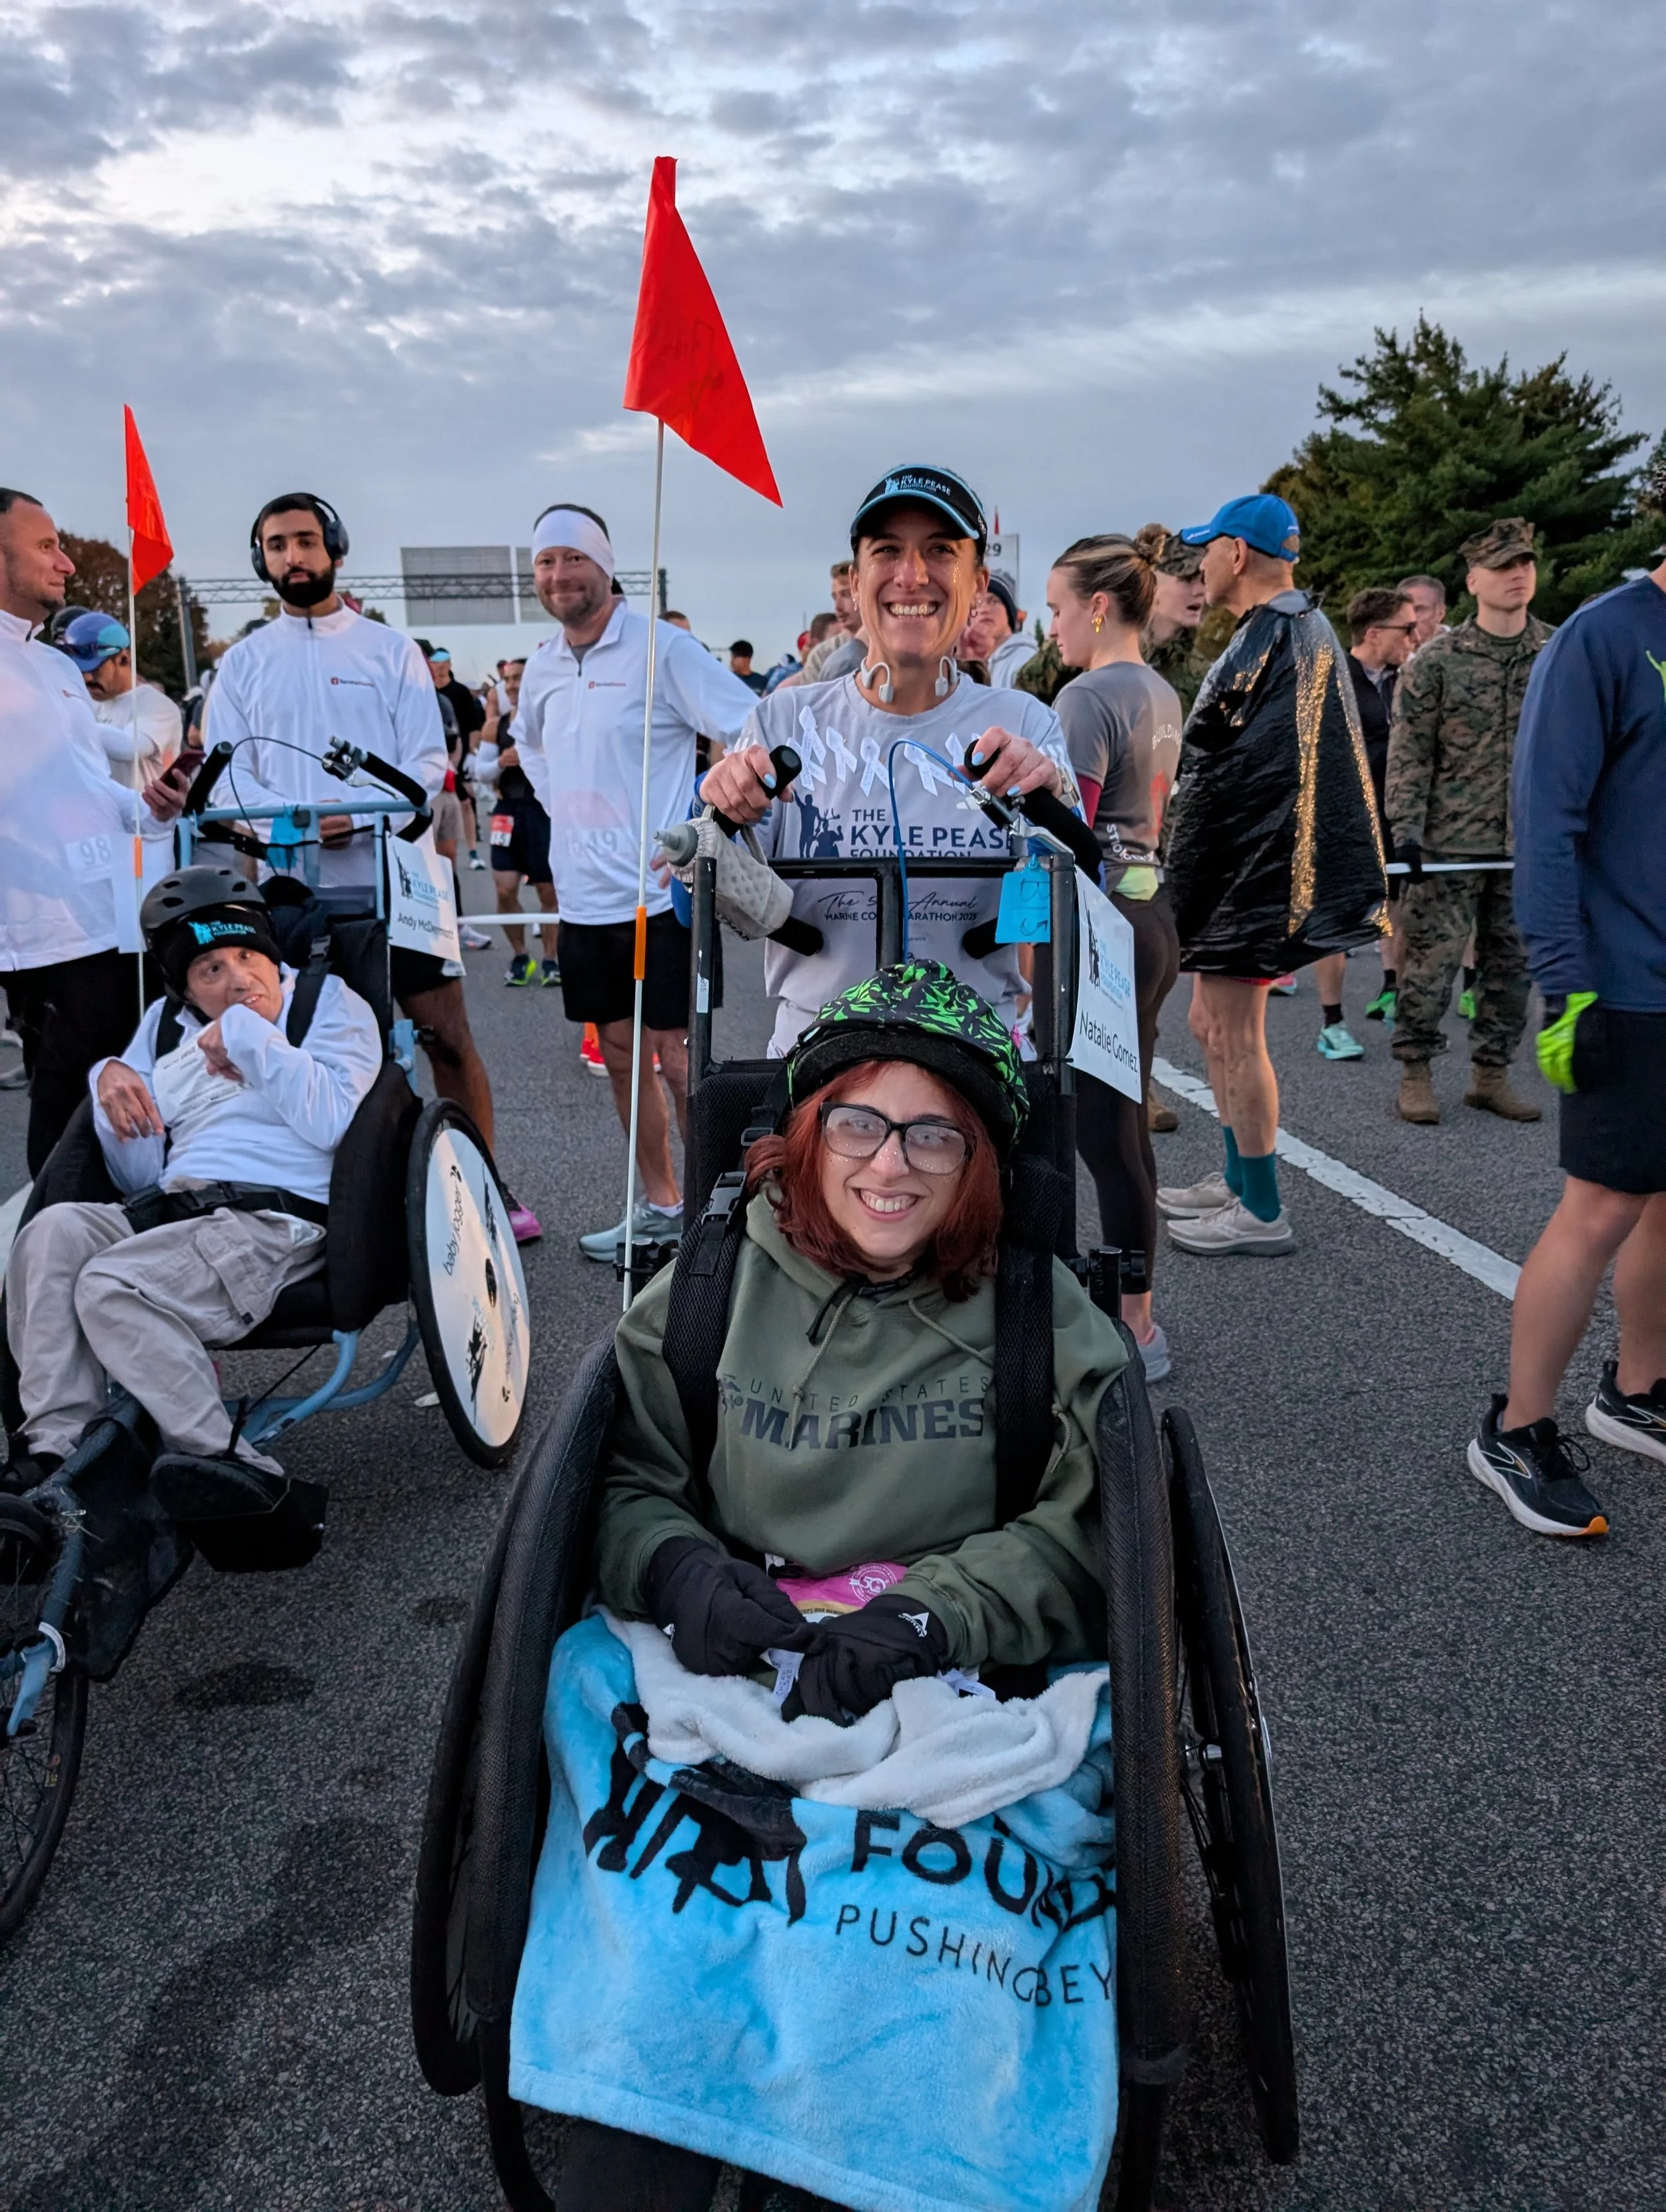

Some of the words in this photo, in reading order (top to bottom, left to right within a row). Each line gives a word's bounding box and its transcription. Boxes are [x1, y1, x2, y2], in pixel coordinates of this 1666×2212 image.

[901, 477, 924, 486] KYLE
[925, 479, 951, 496] PEASE
[852, 809, 886, 822] THE
[850, 825, 924, 846] KYLE
[818, 890, 865, 914] The
[907, 891, 978, 913] Annual
[212, 923, 233, 932] KYLE
[234, 923, 257, 934] PEASE
[398, 912, 416, 931] Andy
[825, 912, 859, 921] MARINE
[906, 912, 957, 922] ARATHON
[1100, 951, 1114, 981] KYLE
[1114, 967, 1131, 998] PEASE
[1080, 1009, 1112, 1054] Natalie
[1112, 1032, 1138, 1073] Gomez
[442, 1233, 460, 1276] baby
[451, 1180, 464, 1241] jogger
[750, 1378, 859, 1412] UNTED
[882, 1376, 990, 1402] STATES
[740, 1397, 985, 1450] MARINES
[836, 1904, 1038, 2002] PUSHING
